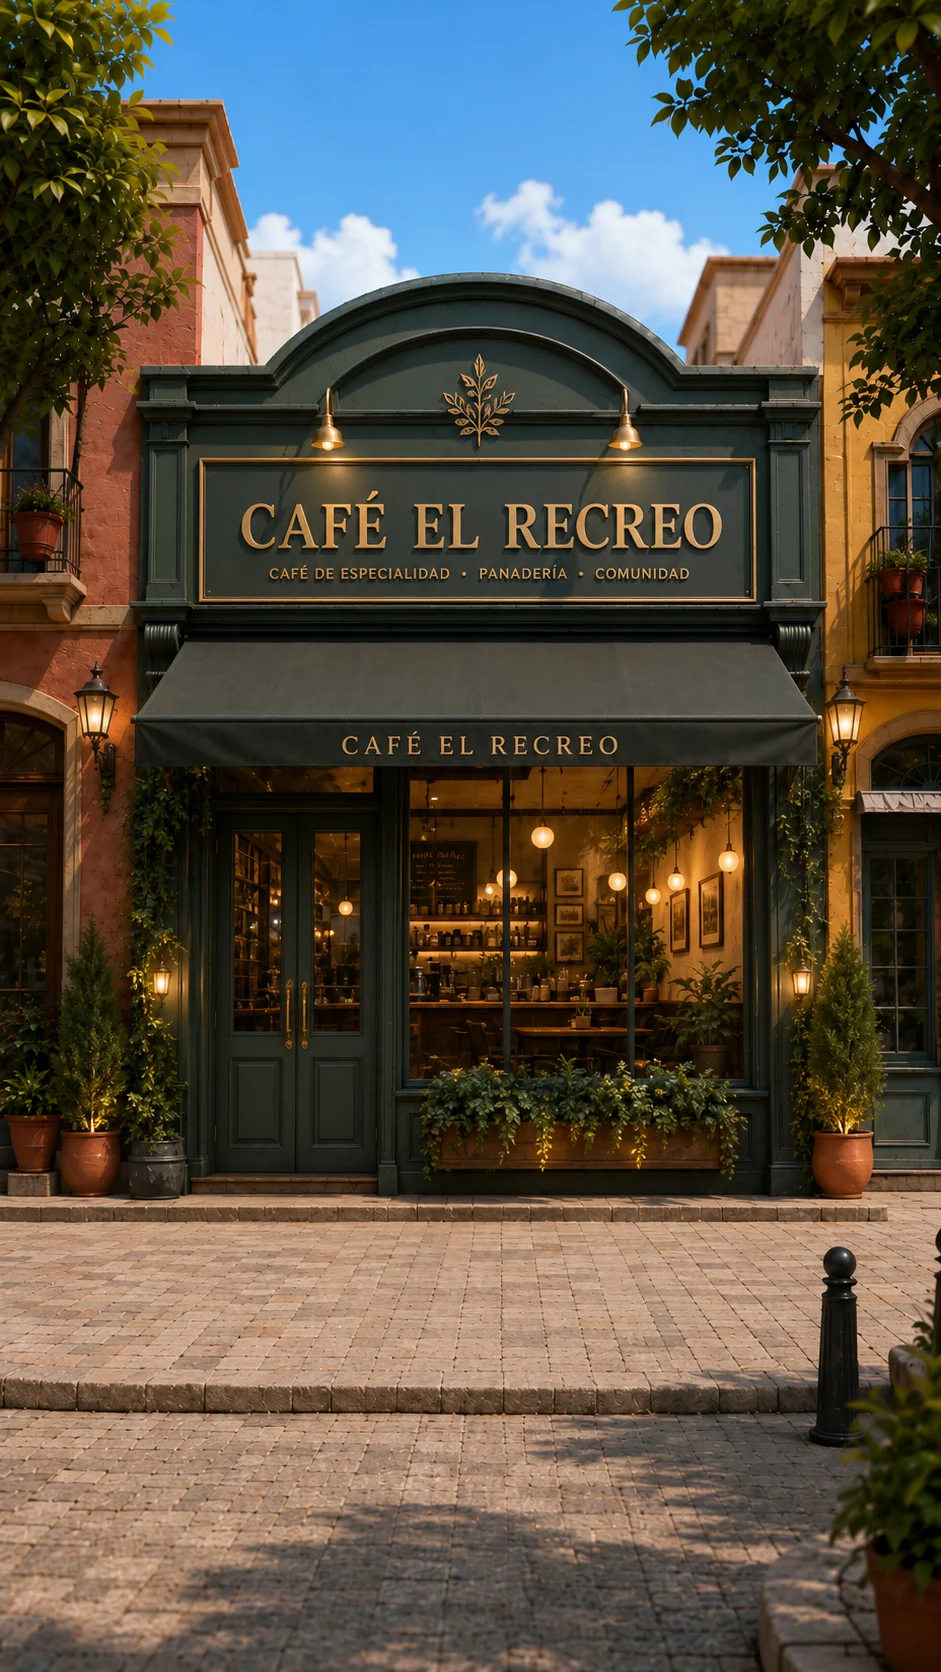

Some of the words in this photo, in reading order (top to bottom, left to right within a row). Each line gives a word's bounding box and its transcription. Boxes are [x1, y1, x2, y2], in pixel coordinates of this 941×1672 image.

[241, 490, 387, 550] CAFÉ
[413, 503, 480, 550] EL
[504, 502, 724, 551] RECREO
[269, 565, 308, 581] CAFÉ
[315, 567, 334, 581] DE
[341, 567, 450, 581] ESPECIALIDAD
[479, 564, 568, 581] PANADERÍA
[595, 567, 691, 581] COMUNIDAD
[340, 730, 421, 756] CAFÉ
[439, 735, 474, 756] EL
[491, 735, 619, 756] RECREO
